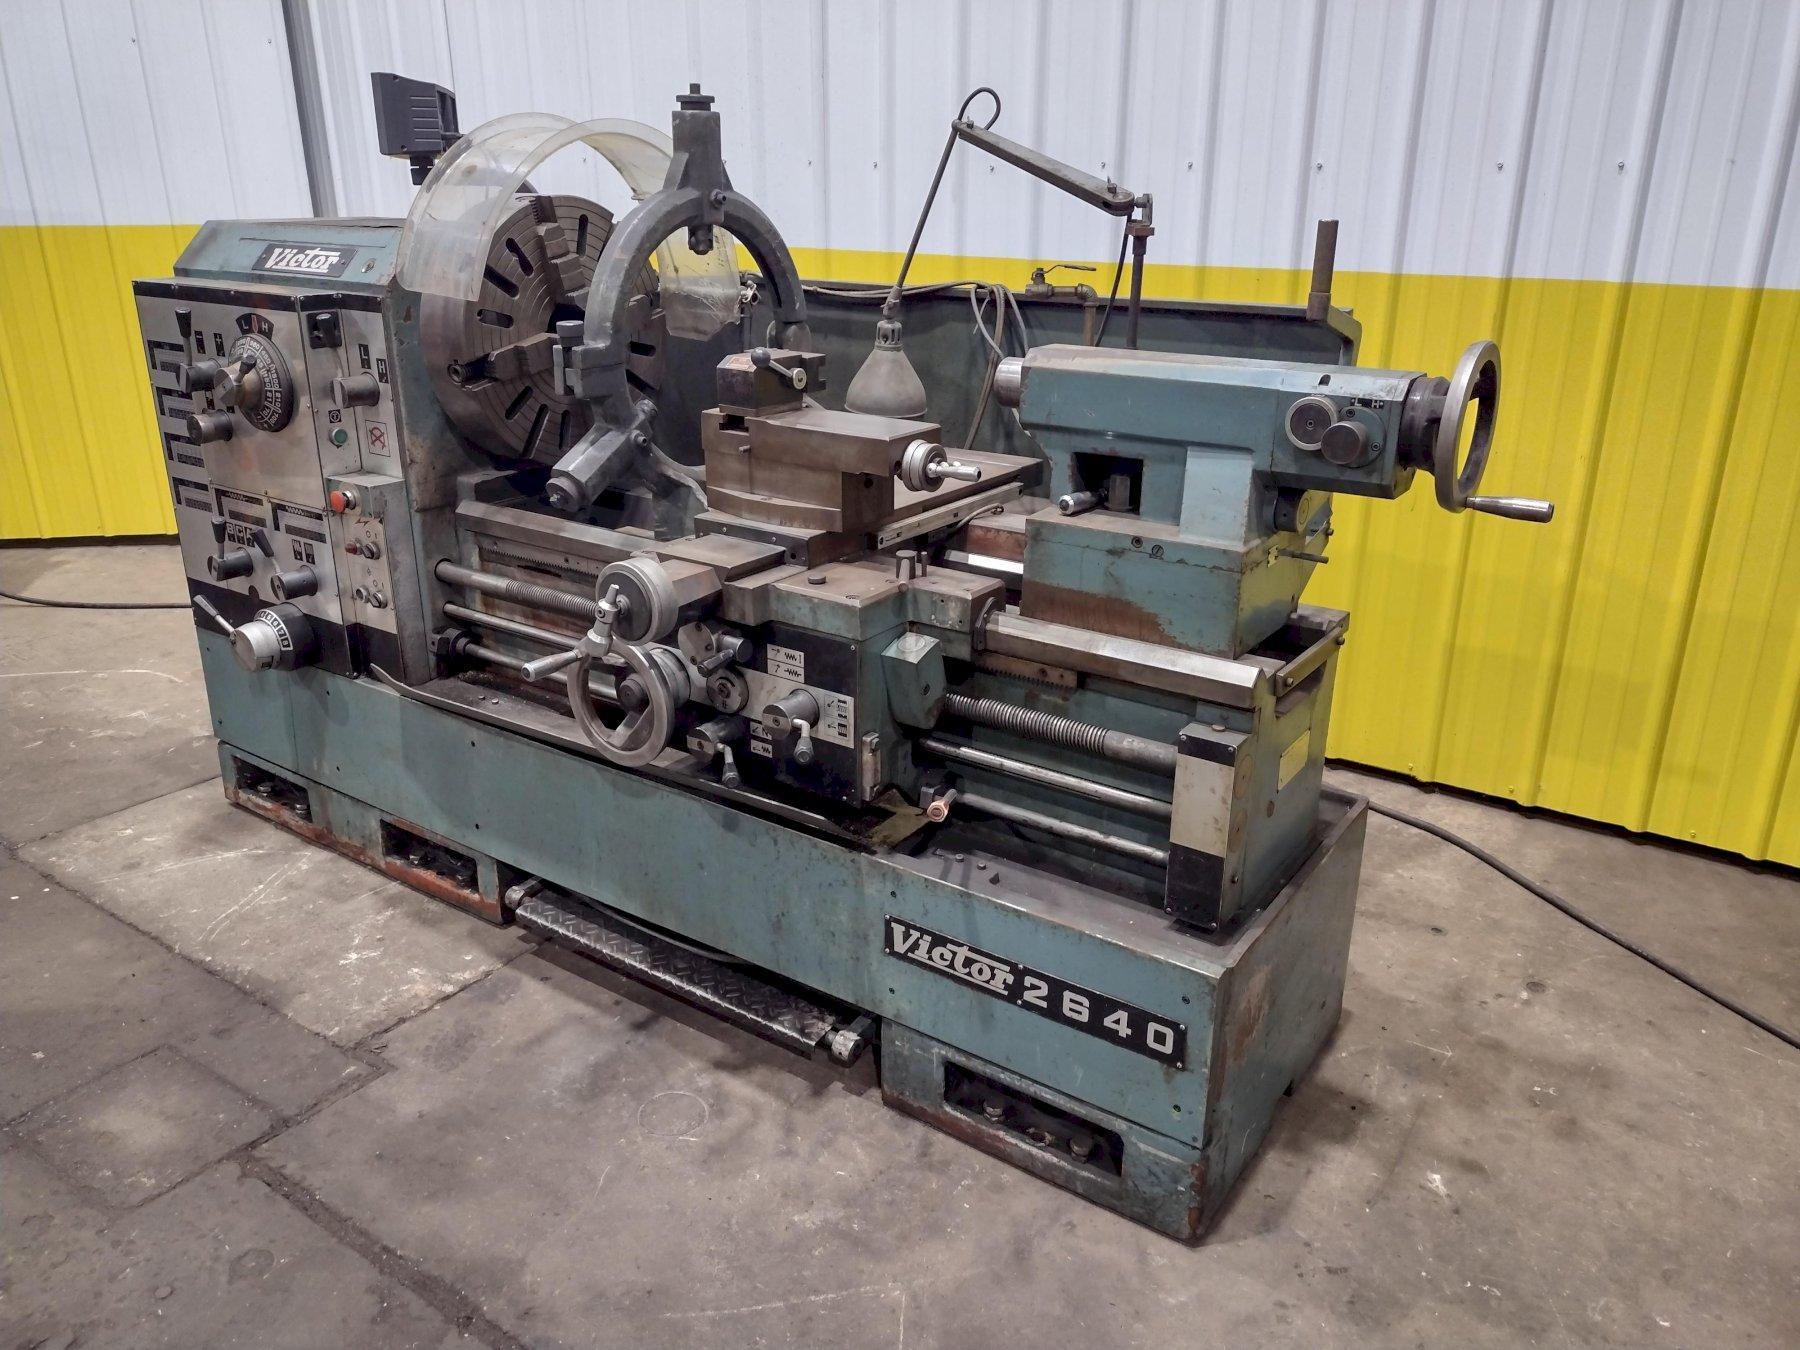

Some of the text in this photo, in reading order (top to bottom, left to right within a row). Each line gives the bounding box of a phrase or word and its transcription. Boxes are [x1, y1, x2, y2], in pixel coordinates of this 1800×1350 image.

[264, 247, 341, 273] Victor
[890, 922, 1175, 1055] Victor 2640
